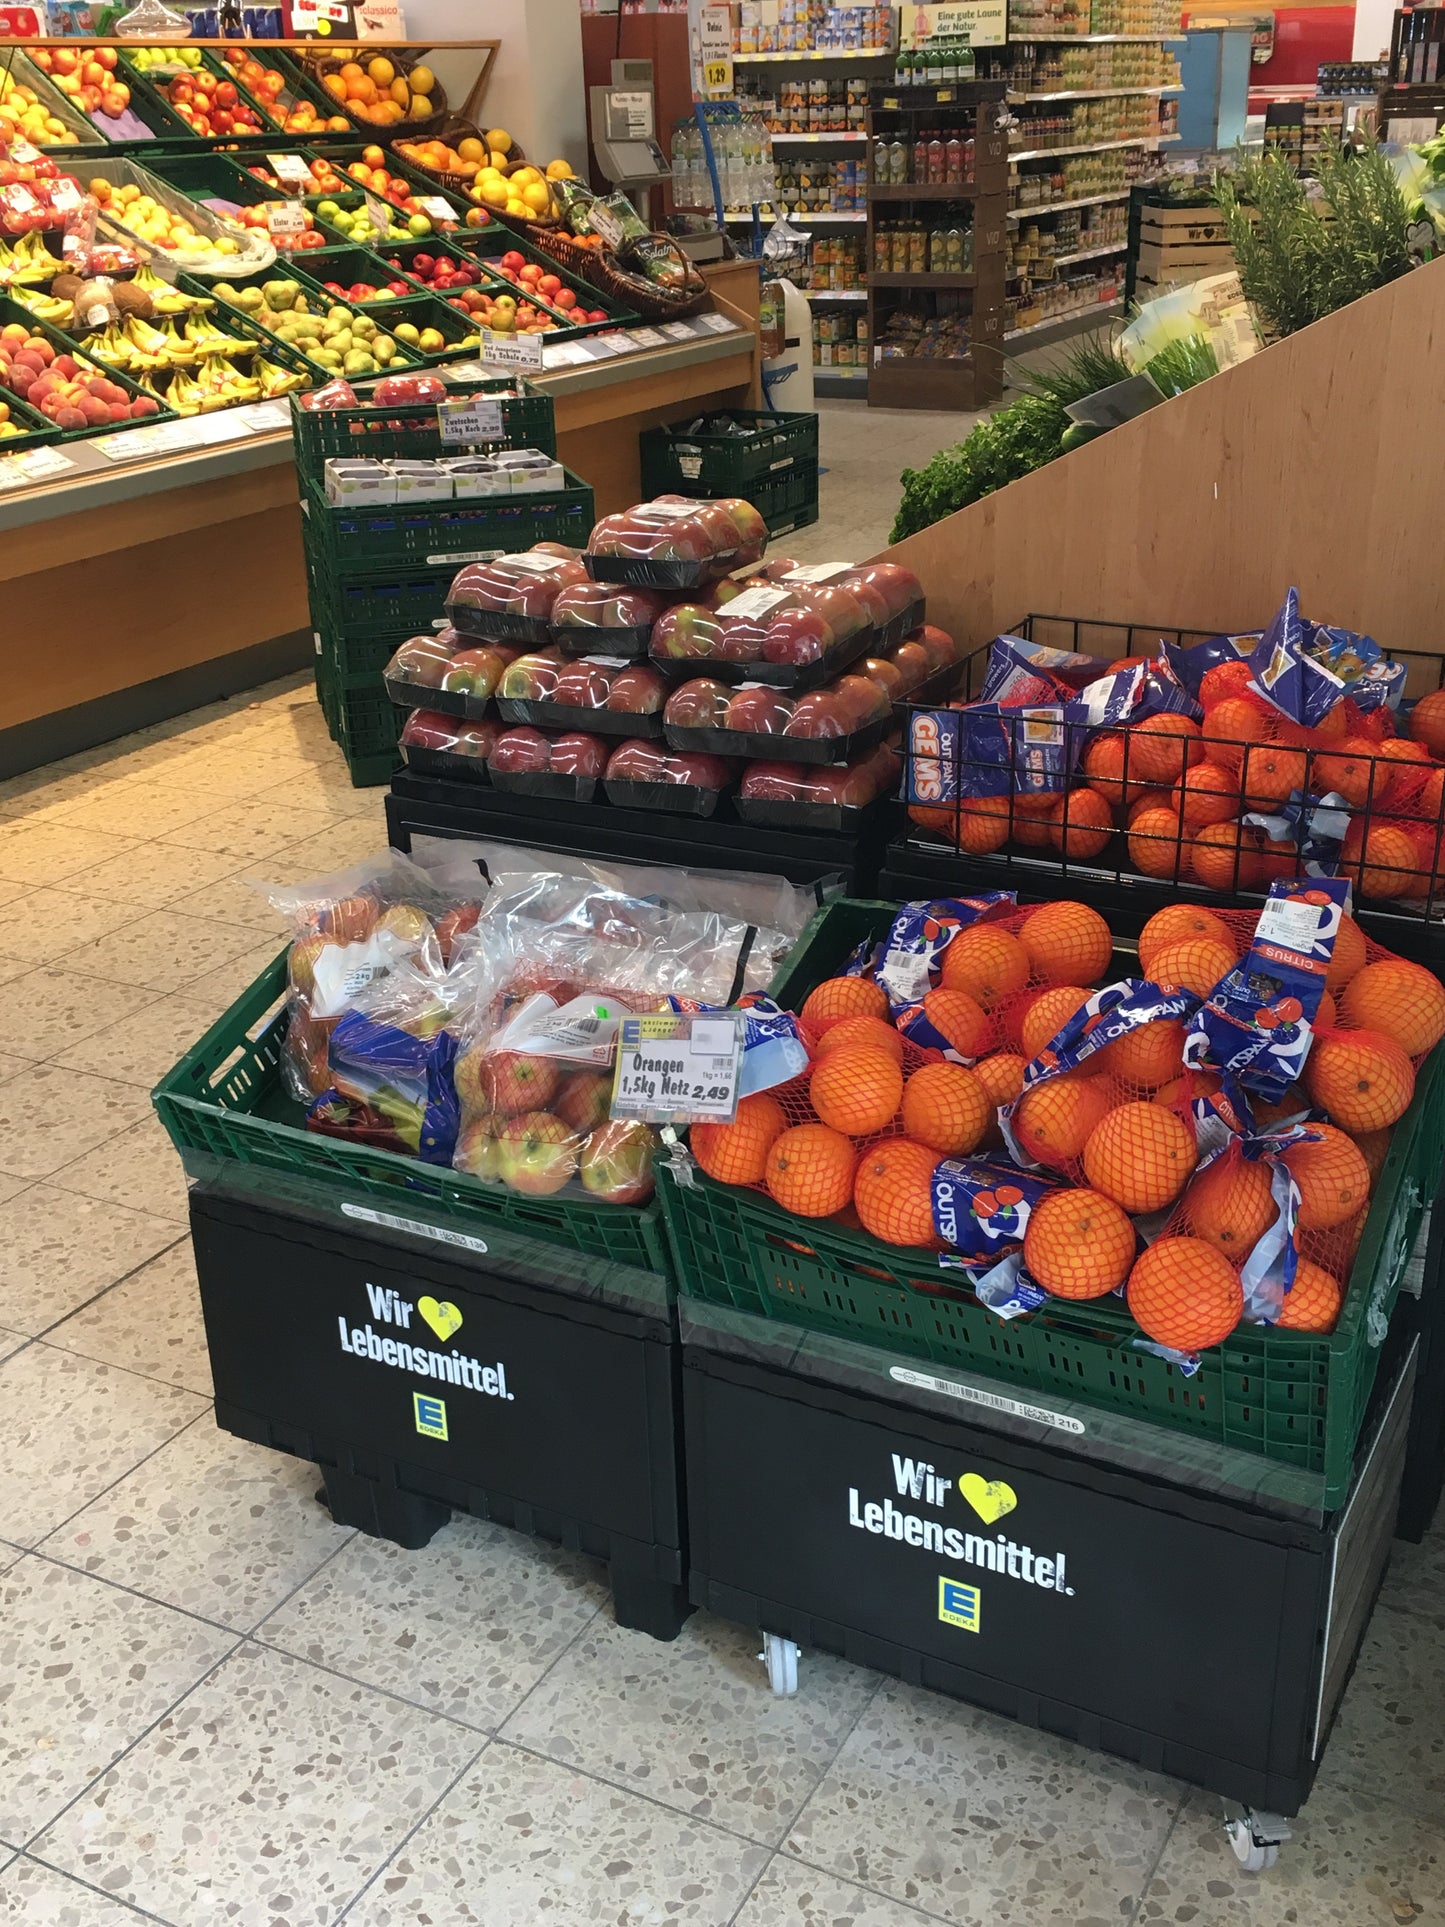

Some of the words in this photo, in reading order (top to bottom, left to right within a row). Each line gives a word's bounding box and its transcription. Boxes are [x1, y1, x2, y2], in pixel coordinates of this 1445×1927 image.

[938, 12, 955, 20] Eine
[957, 11, 975, 21] gute
[977, 9, 1002, 18] Laune
[937, 24, 950, 32] der
[953, 22, 977, 31] Natur.
[709, 67, 725, 84] 1,29
[1189, 229, 1201, 239] Wir
[521, 356, 539, 364] 0,79
[445, 416, 478, 426] Zwetschen
[465, 425, 480, 433] Korb
[912, 715, 942, 800] GEMS
[940, 732, 955, 784] OUTPAN
[1265, 947, 1314, 970] CITRUS
[623, 1020, 640, 1043] E
[633, 1053, 684, 1077] Orangen
[703, 1071, 713, 1081] 1kg
[623, 1075, 656, 1100] 1,5kg
[661, 1075, 690, 1096] Netz
[691, 1085, 729, 1101] 2,49
[366, 1283, 413, 1329] Wir
[338, 1316, 515, 1401] Lebensmittel.
[416, 1397, 444, 1430] E
[1058, 1417, 1080, 1431] 216
[418, 1423, 446, 1437] EDEKA
[891, 1453, 952, 1507] Wir
[849, 1487, 1076, 1597] Lebensmittel.
[943, 1582, 976, 1621] E
[942, 1612, 976, 1628] EDEKA
